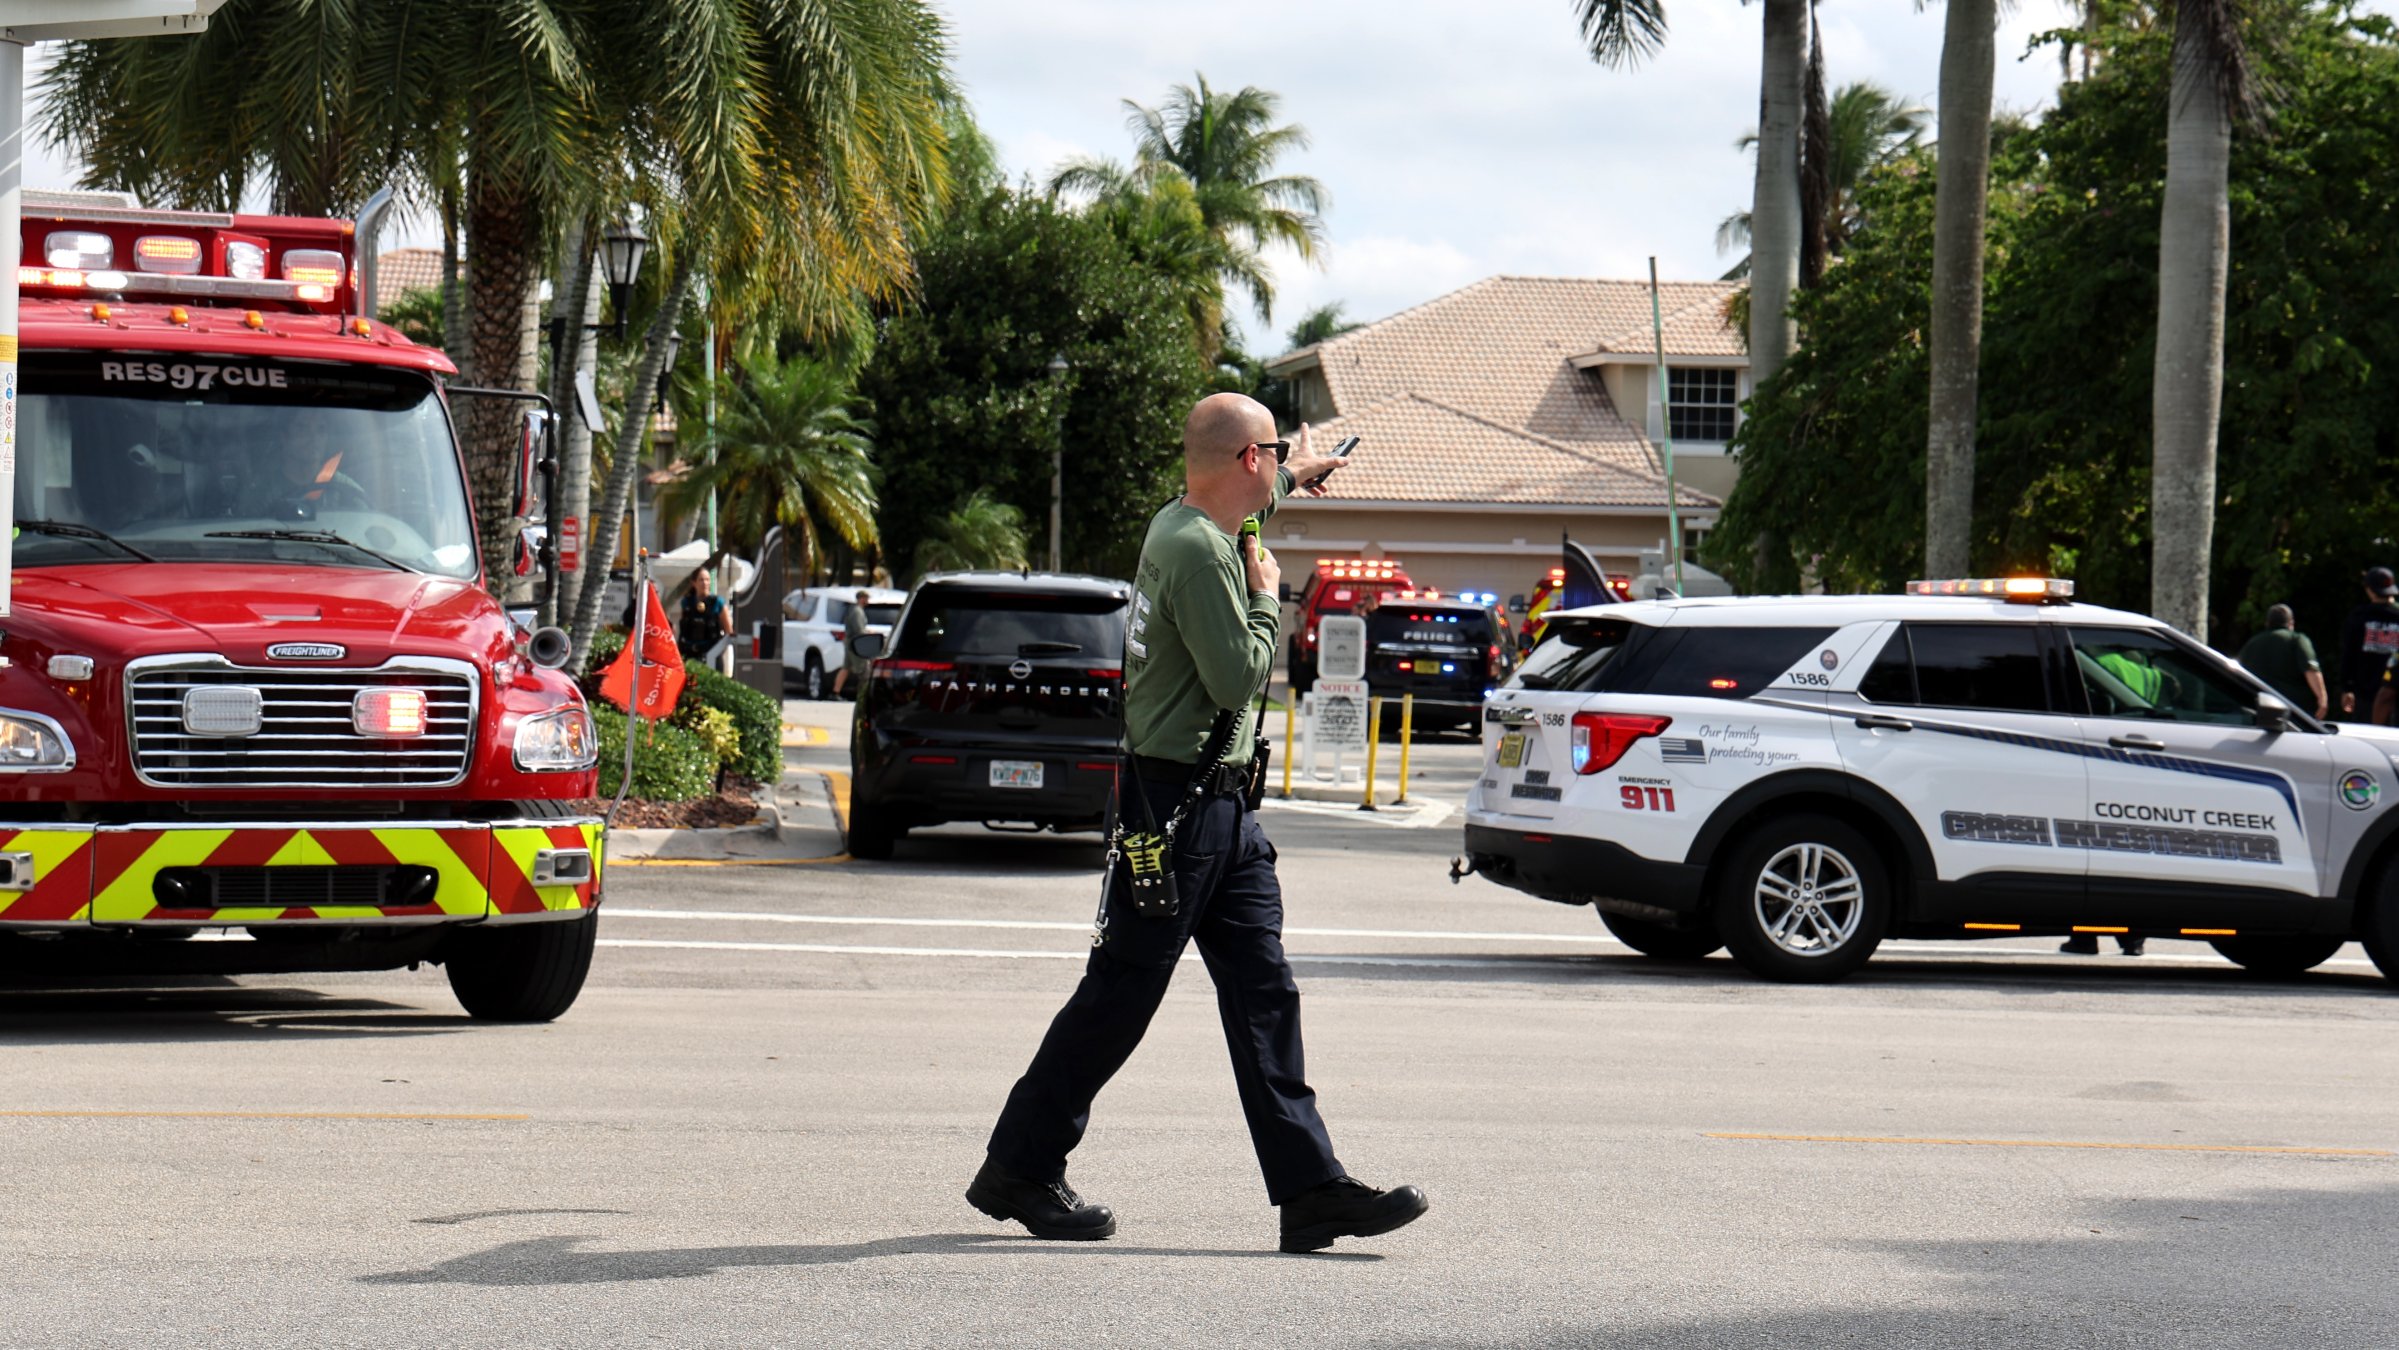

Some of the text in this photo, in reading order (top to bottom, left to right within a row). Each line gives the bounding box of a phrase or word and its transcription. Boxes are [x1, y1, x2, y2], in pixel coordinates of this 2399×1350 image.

[1403, 630, 1455, 642] POLICE
[275, 645, 338, 657] FREIGHTLINER
[1788, 672, 1829, 686] 1586
[930, 680, 1109, 697] PATHFINDER
[1320, 683, 1361, 694] NOTICE
[1542, 713, 1566, 727] 1586
[1699, 724, 1760, 746] Our family
[1708, 746, 1801, 767] protecting yours.
[1618, 775, 1671, 786] EMERGENCY
[1620, 785, 1676, 812] 911
[2094, 802, 2277, 830] COCONUT CREEK
[1940, 810, 2053, 847] CRASH
